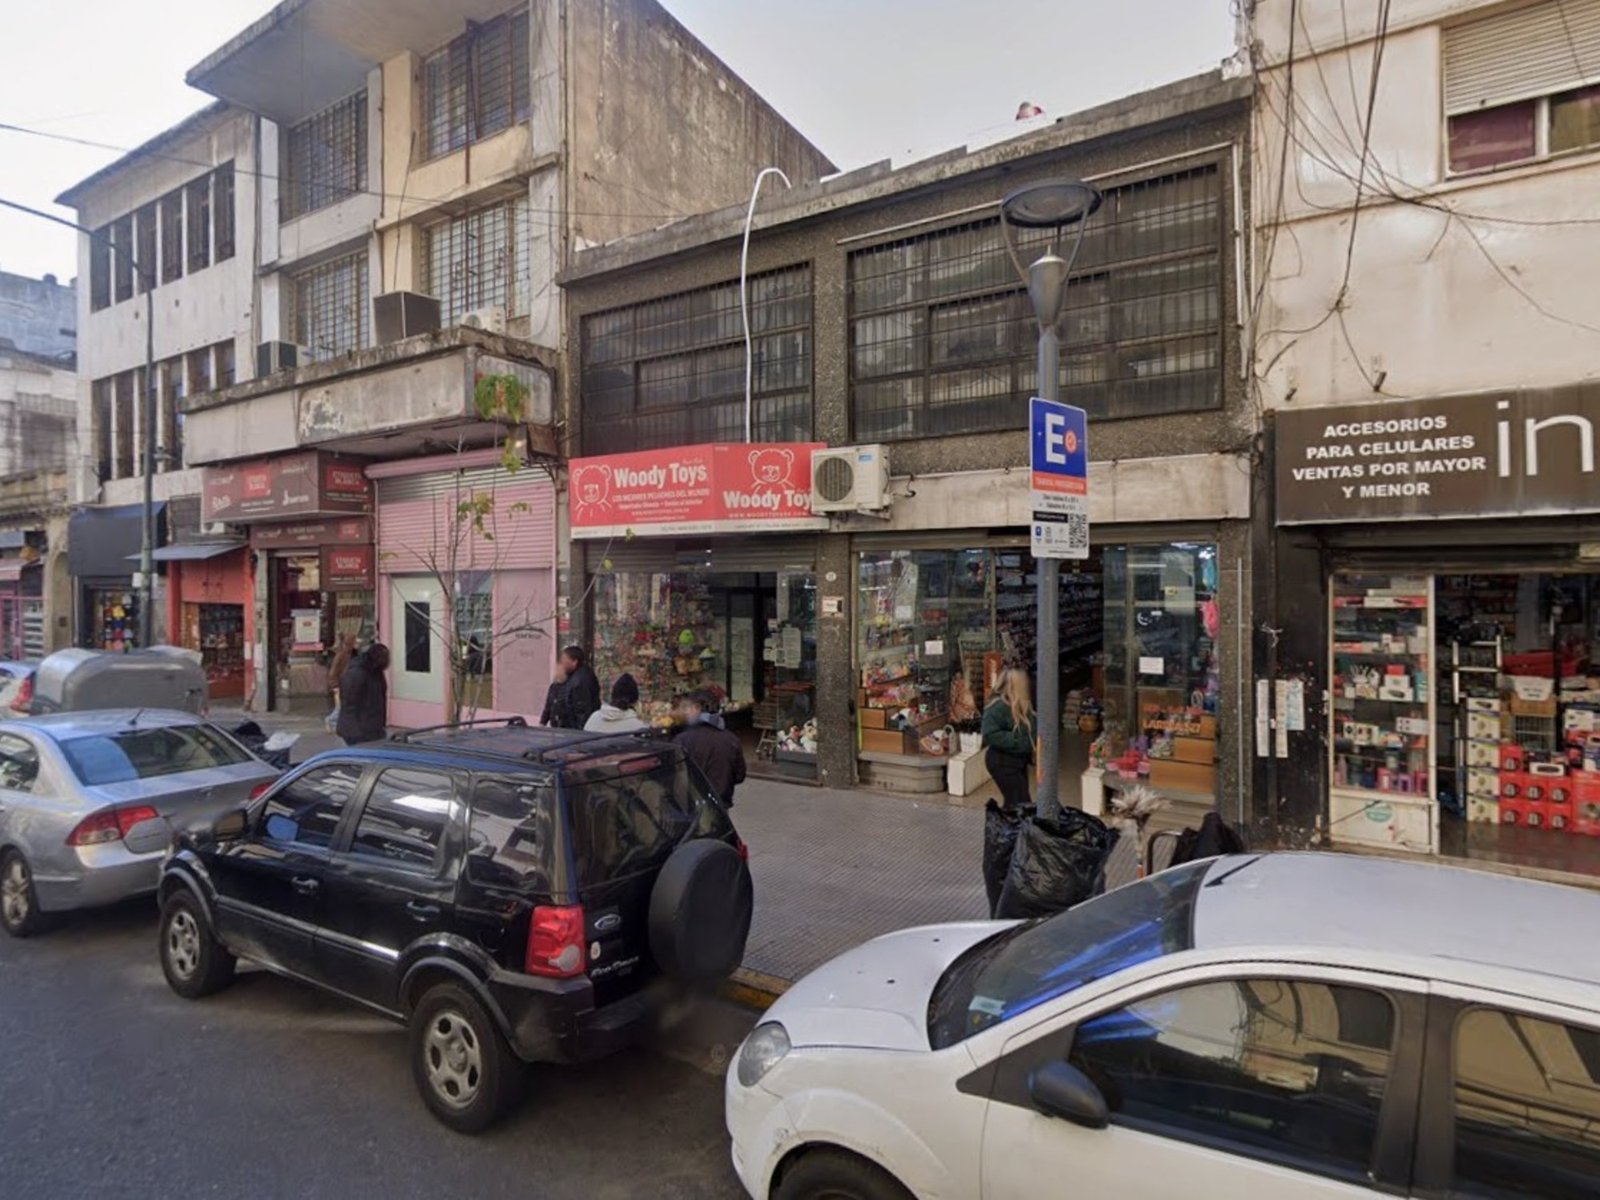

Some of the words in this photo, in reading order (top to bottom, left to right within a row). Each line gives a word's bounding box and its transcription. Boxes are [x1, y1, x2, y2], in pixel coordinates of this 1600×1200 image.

[1045, 412, 1066, 465] E
[1323, 415, 1447, 438] ACCESORIOS
[1497, 400, 1594, 477] in
[1306, 444, 1354, 460] PARA
[1359, 435, 1475, 456] CELULARES
[613, 465, 666, 489] Woody
[669, 463, 707, 487] Toys
[1292, 464, 1364, 481] VENTAS
[1369, 460, 1409, 477] POR
[1415, 456, 1486, 474] MAYOR
[723, 489, 781, 511] Woody
[784, 489, 812, 511] Toy
[1341, 486, 1355, 499] Y
[1359, 482, 1431, 498] MENOR
